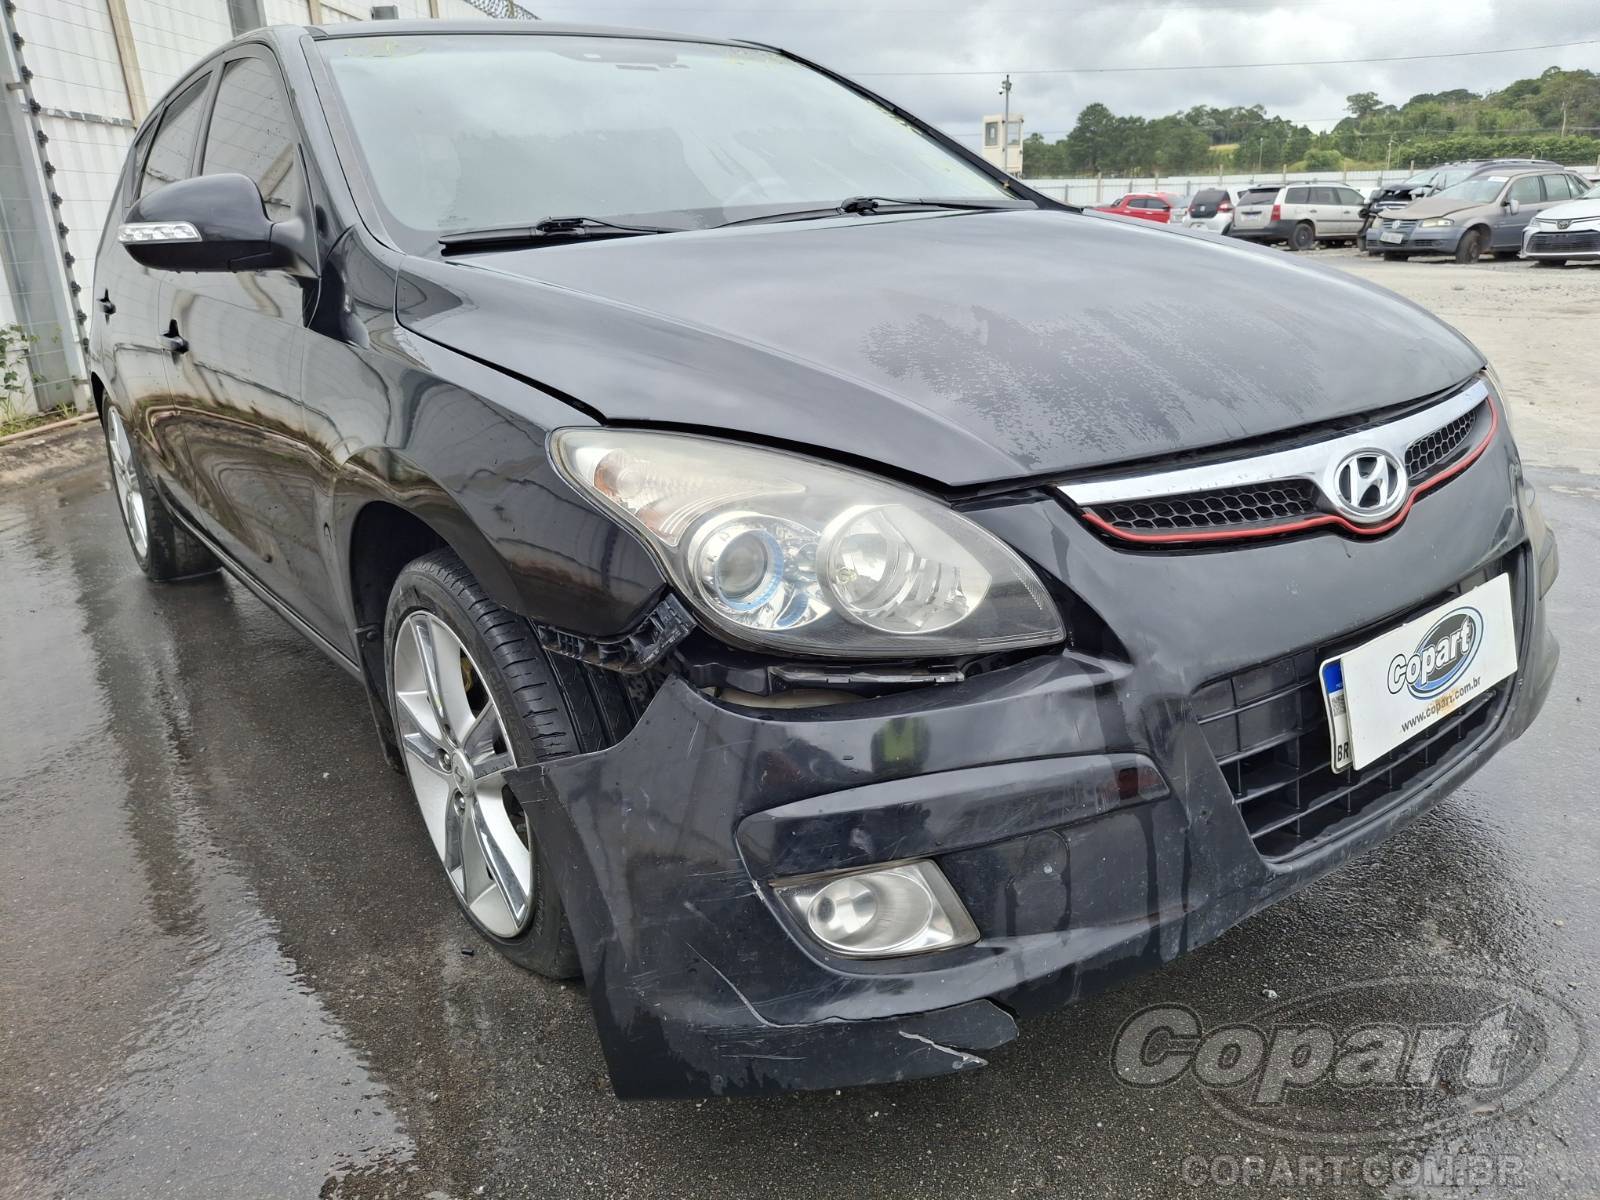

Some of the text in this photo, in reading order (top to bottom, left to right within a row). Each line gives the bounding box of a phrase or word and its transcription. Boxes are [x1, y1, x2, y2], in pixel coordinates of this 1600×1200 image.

[1387, 615, 1472, 694] Copart
[1401, 676, 1481, 732] www.copart.com.br
[1337, 742, 1349, 762] BR
